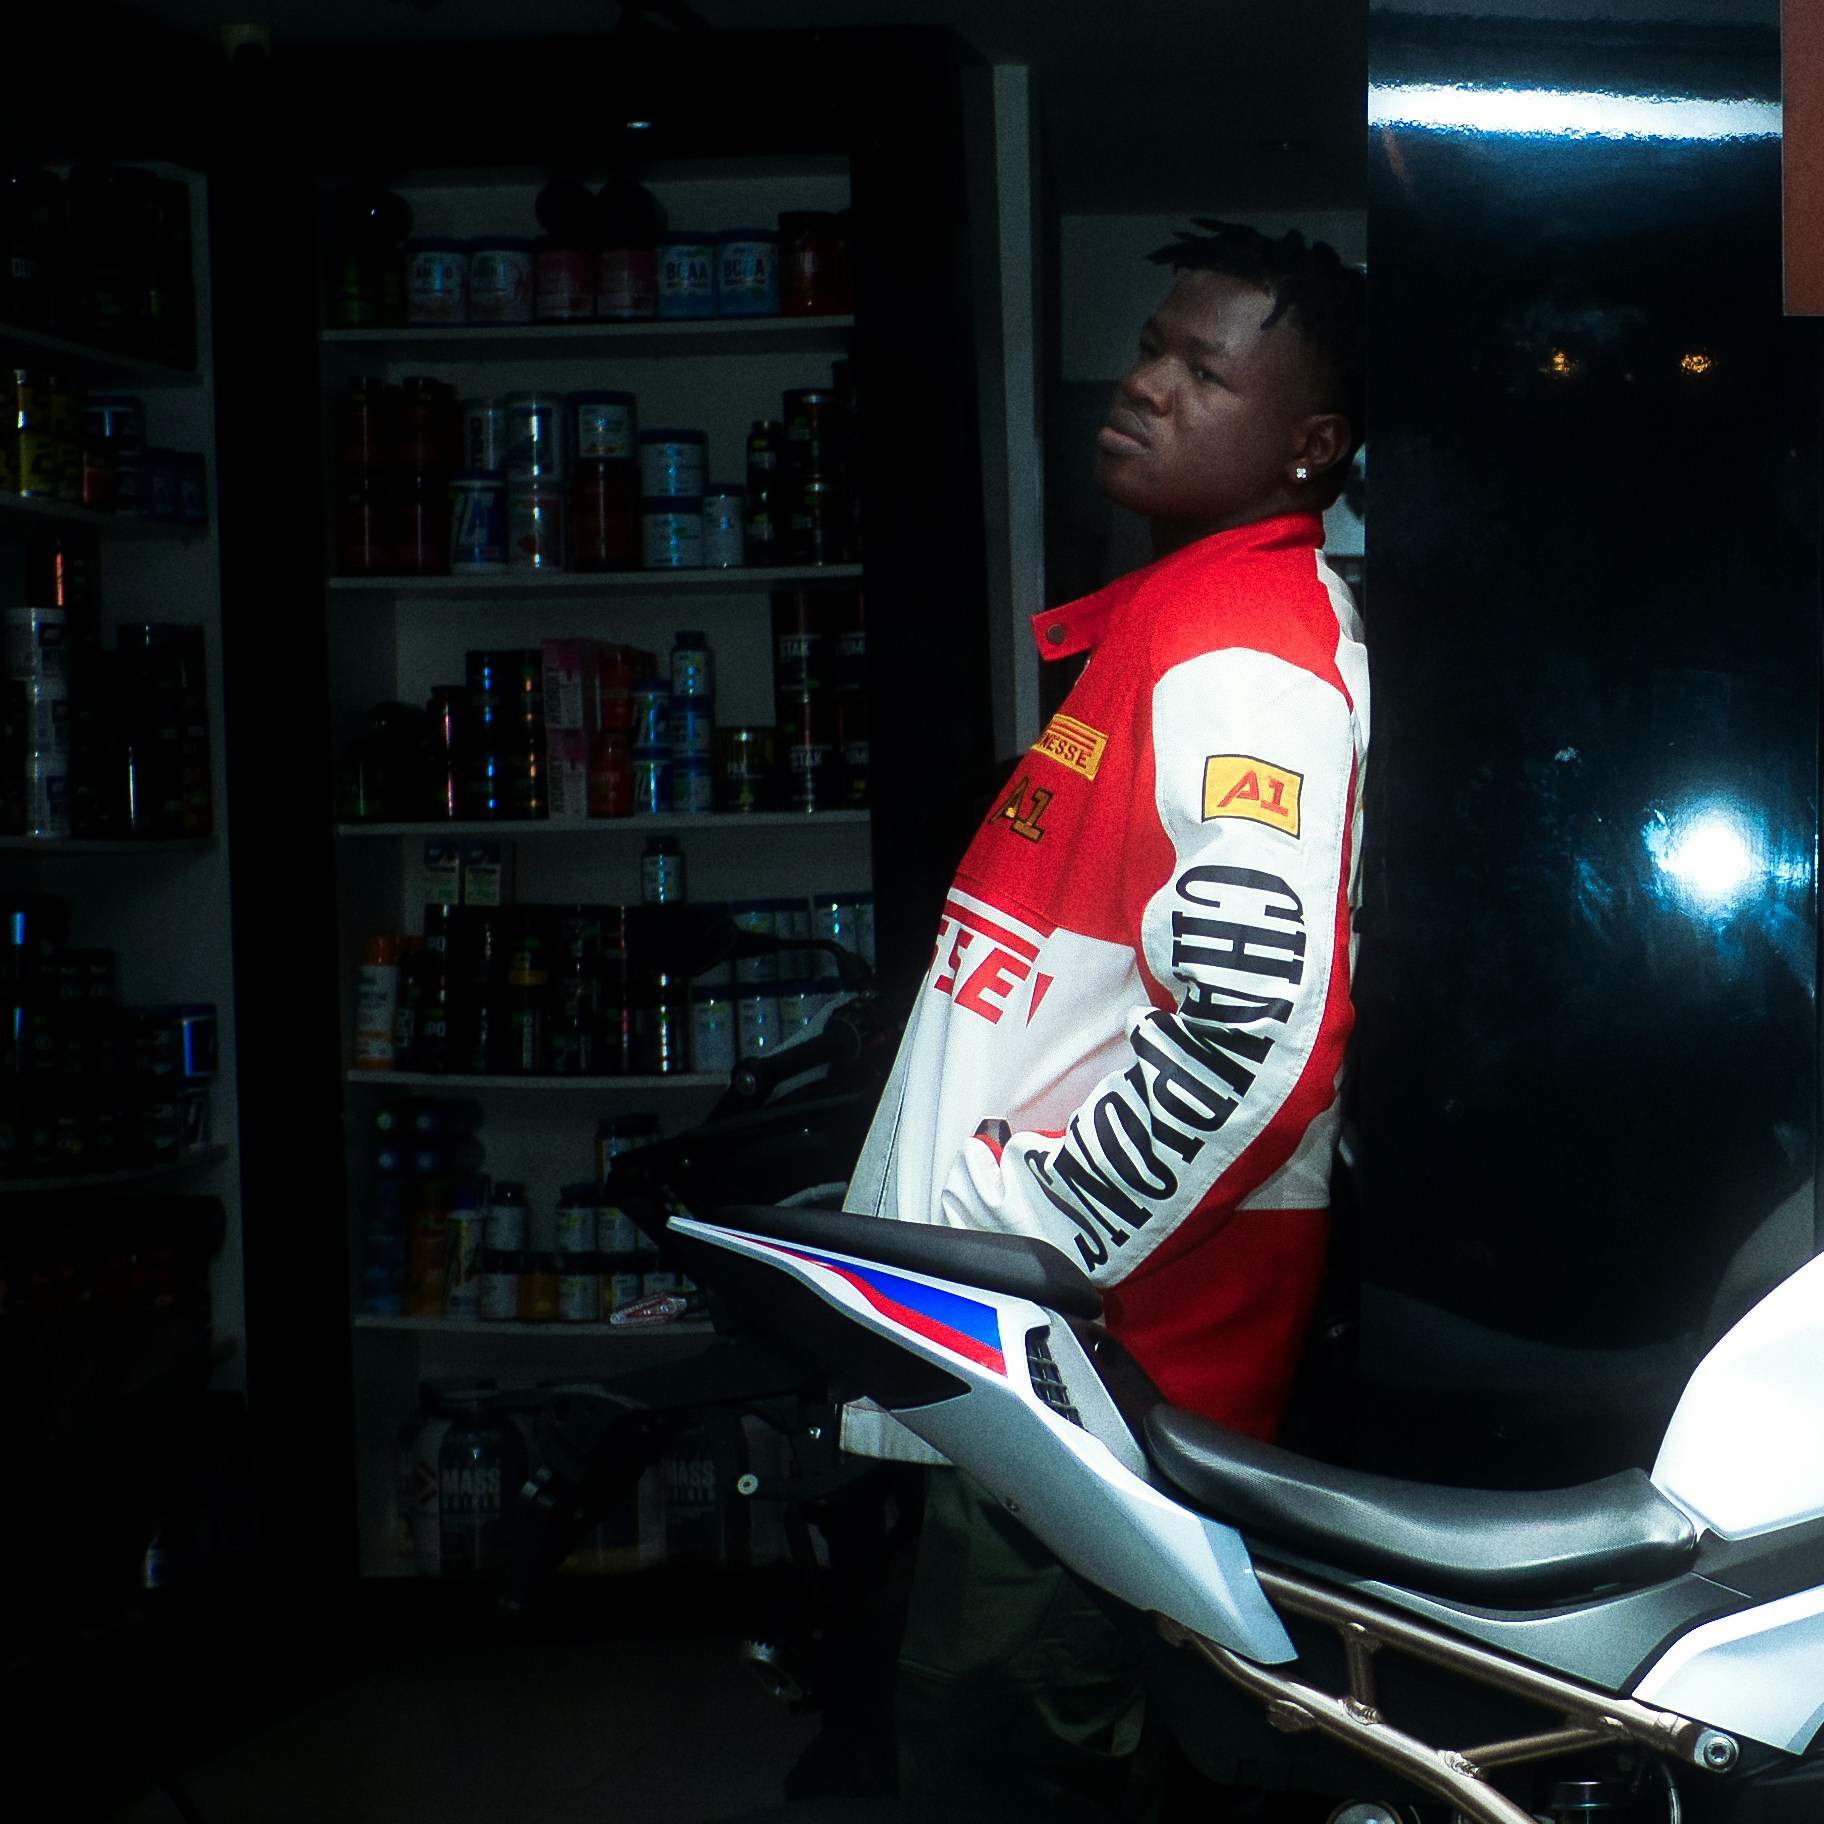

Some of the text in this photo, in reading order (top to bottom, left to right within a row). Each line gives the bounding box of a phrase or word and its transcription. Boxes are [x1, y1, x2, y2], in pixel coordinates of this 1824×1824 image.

[988, 774, 1053, 844] A1
[1216, 769, 1289, 817] A1
[1024, 865, 1307, 1273] CHAMPIONS
